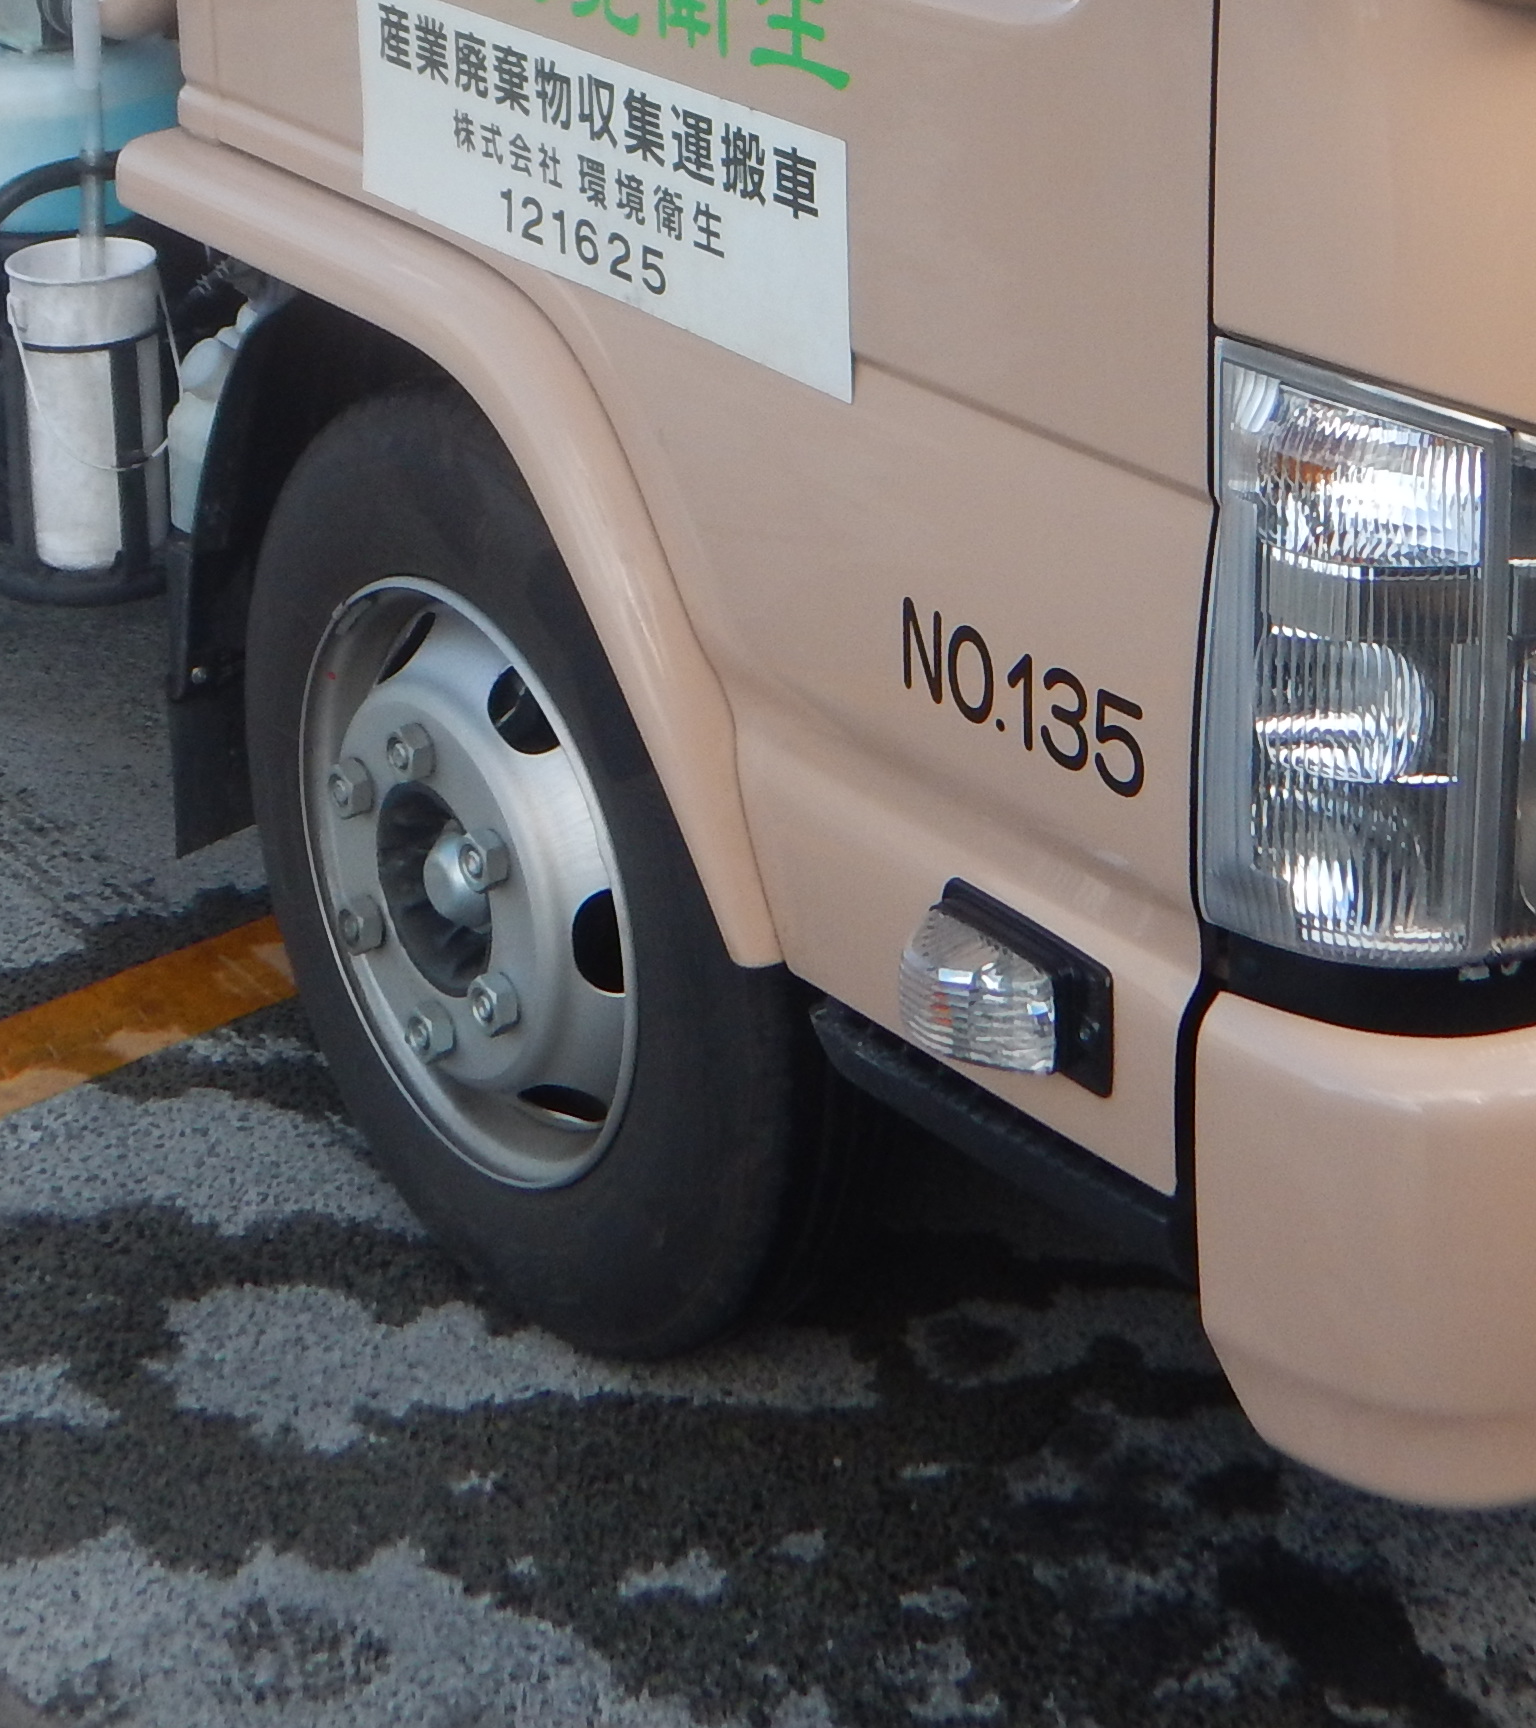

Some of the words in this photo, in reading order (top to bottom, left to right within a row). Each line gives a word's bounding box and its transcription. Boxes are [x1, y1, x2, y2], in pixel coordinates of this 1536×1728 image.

[377, 2, 820, 220] 産業廃棄物収集運搬車
[453, 108, 563, 190] 株式会社
[576, 153, 726, 260] 環境衛生
[500, 187, 667, 296] 121625
[902, 595, 1145, 798] NO.135
